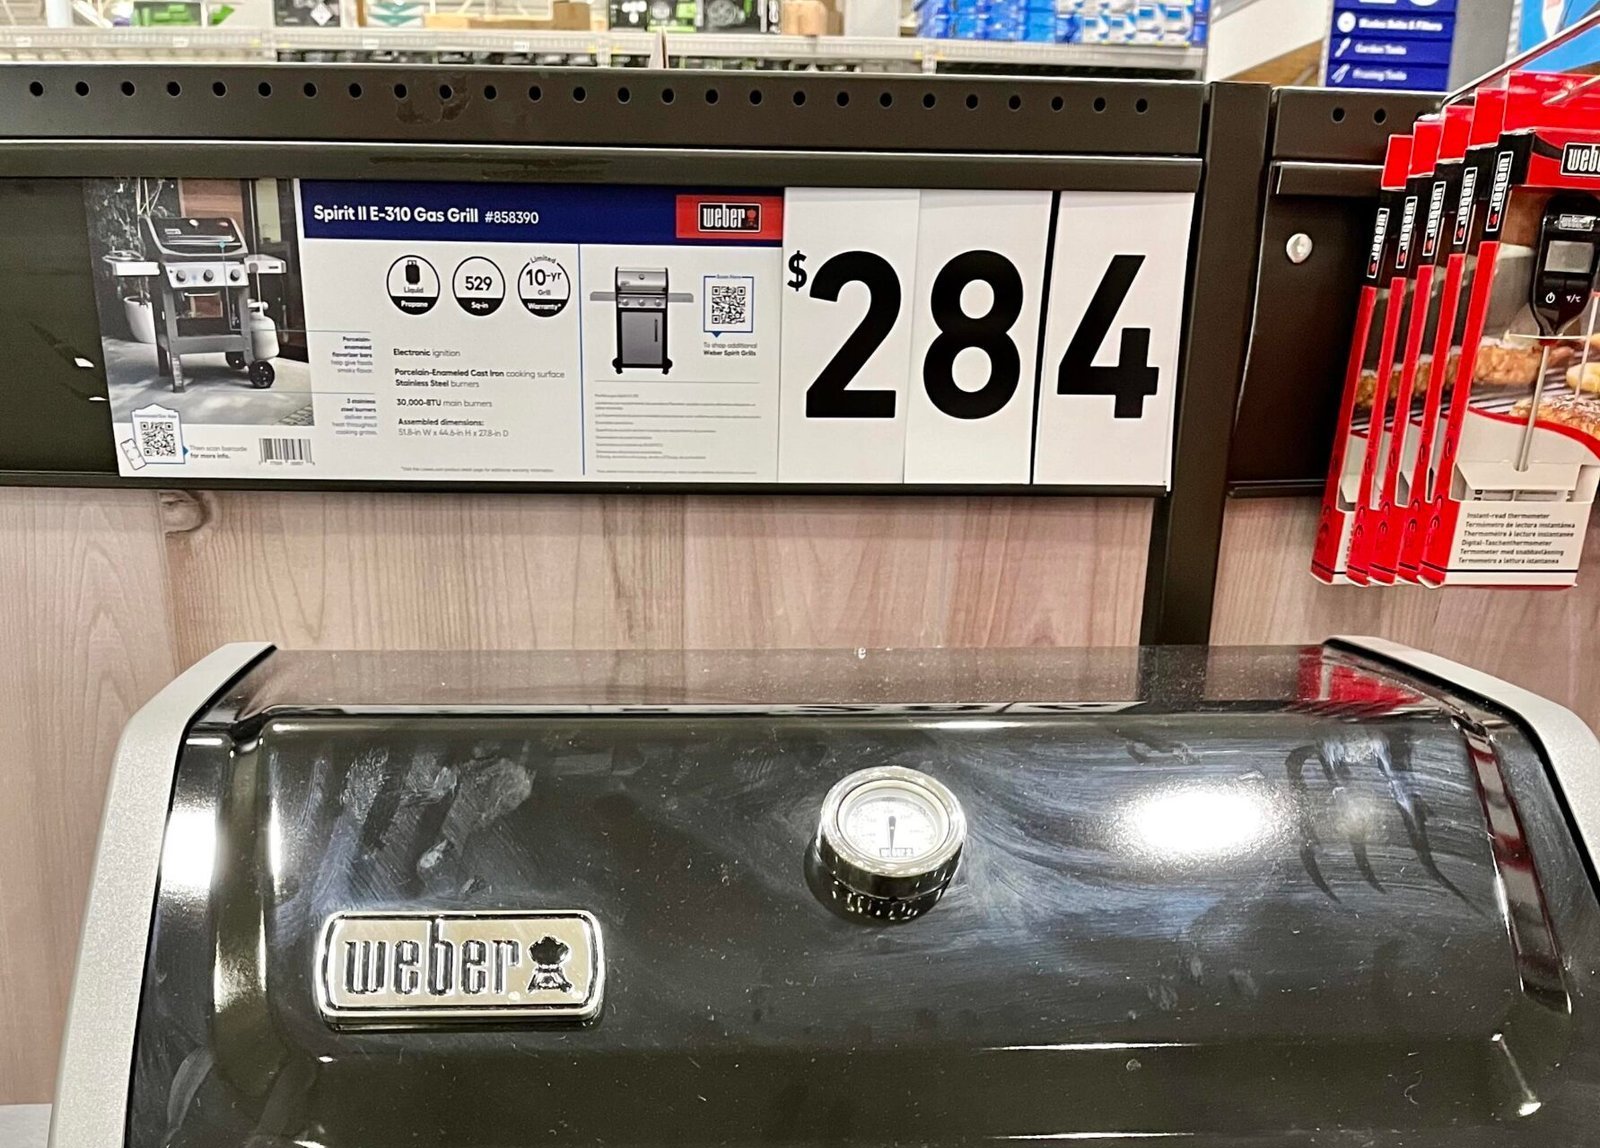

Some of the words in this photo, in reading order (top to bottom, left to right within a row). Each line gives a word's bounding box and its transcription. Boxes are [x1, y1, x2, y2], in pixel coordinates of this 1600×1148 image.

[1493, 156, 1511, 211] weber
[1459, 173, 1476, 226] weber
[313, 205, 355, 222] Spirit
[369, 208, 411, 222] E-310
[414, 207, 445, 223] Gas
[447, 208, 479, 223] Grill
[485, 211, 539, 224] #858390
[703, 204, 745, 228] weber
[1428, 187, 1444, 238] weber
[1402, 202, 1416, 250] weber
[1373, 212, 1388, 261] weber
[530, 255, 557, 264] Limited
[465, 276, 493, 291] 529
[526, 268, 562, 287] 10-yr
[403, 286, 424, 294] Liquid
[538, 289, 551, 297] Grill
[401, 300, 428, 309] Propane
[471, 301, 489, 310] Sq-in
[393, 348, 431, 357] Electronic
[432, 348, 461, 358] ignition
[394, 368, 469, 377] Porcelain-Enameled
[470, 369, 489, 378] Cast
[489, 370, 505, 378] Iron
[505, 371, 536, 380] cooking
[537, 370, 565, 379] surface
[395, 379, 429, 388] Stainless
[430, 379, 449, 388] Steel
[450, 379, 480, 388] burners
[396, 398, 442, 408] 30,000-BTU
[442, 400, 463, 408] main
[463, 399, 492, 408] burners
[398, 418, 439, 427] Assembled
[440, 419, 485, 427] dimensions:
[422, 429, 432, 437] W
[464, 430, 472, 438] H
[502, 430, 510, 438] D
[344, 919, 521, 996] weber
